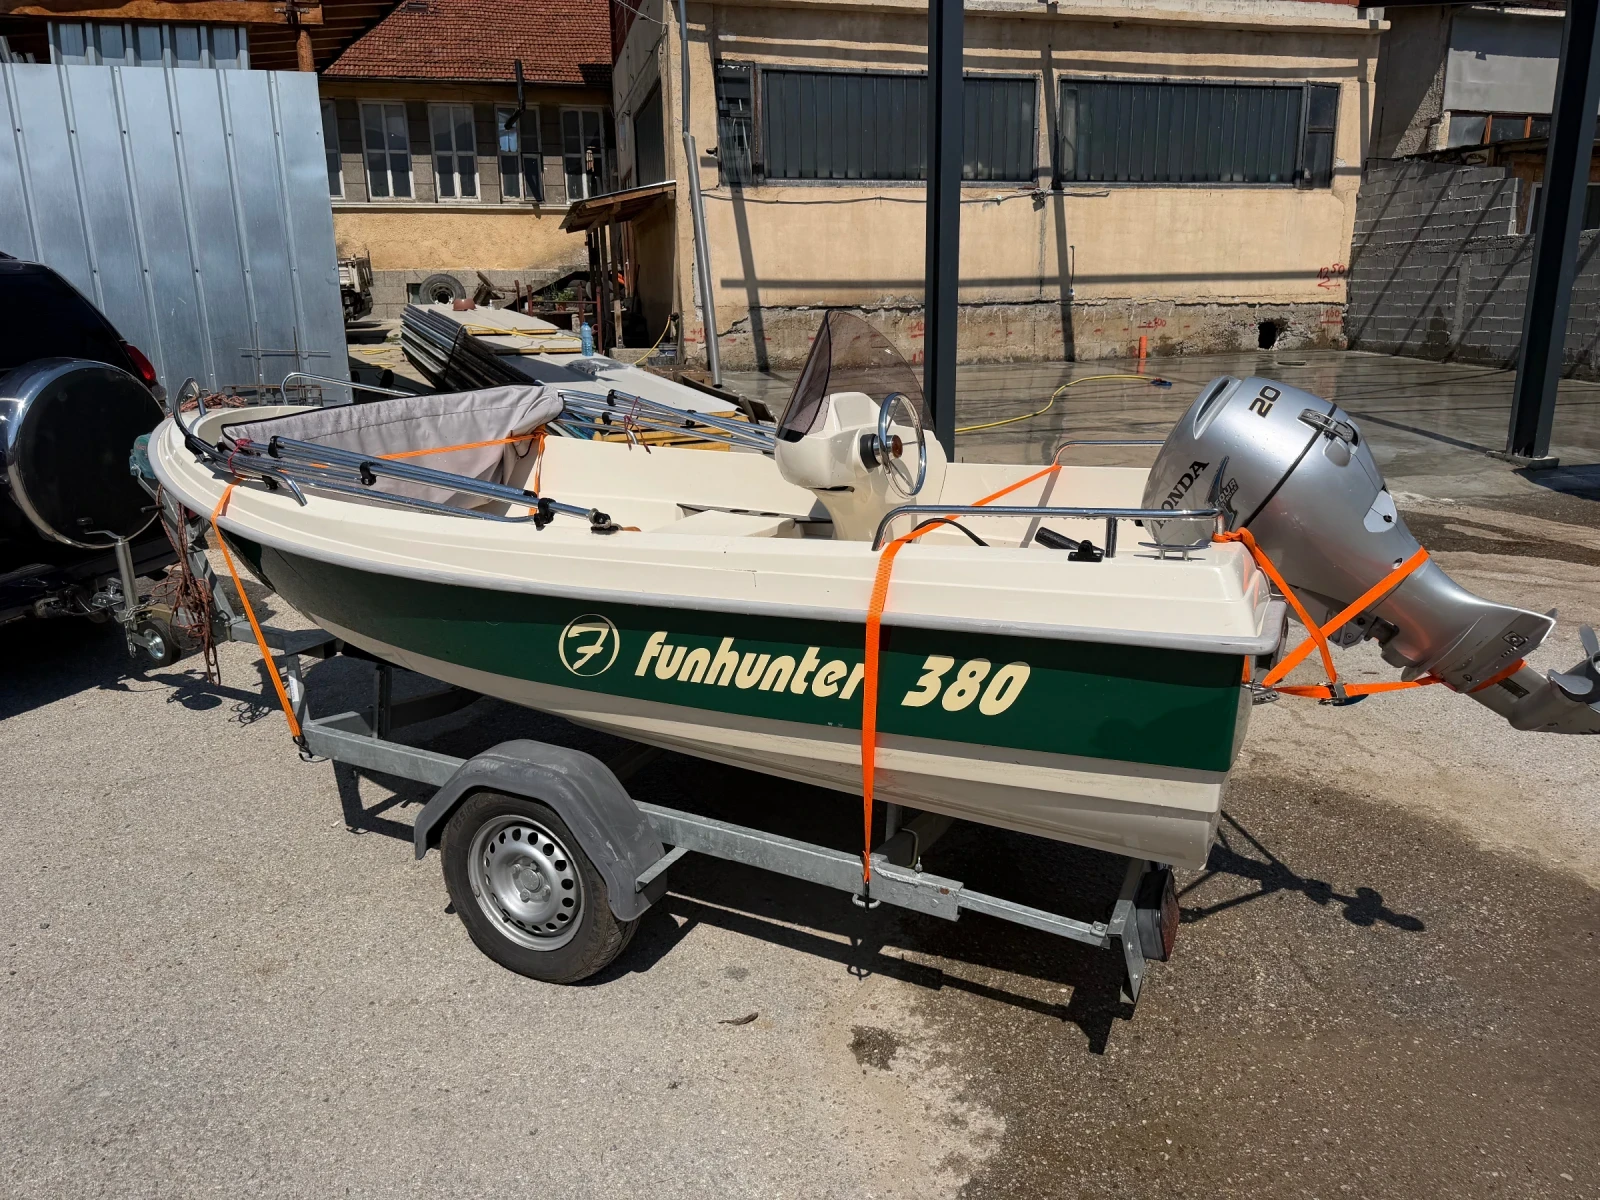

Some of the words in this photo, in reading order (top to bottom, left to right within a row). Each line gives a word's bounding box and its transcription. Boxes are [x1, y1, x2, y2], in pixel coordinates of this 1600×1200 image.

[1248, 385, 1282, 418] 20
[634, 630, 865, 700] funhunter
[901, 654, 1031, 717] 380
